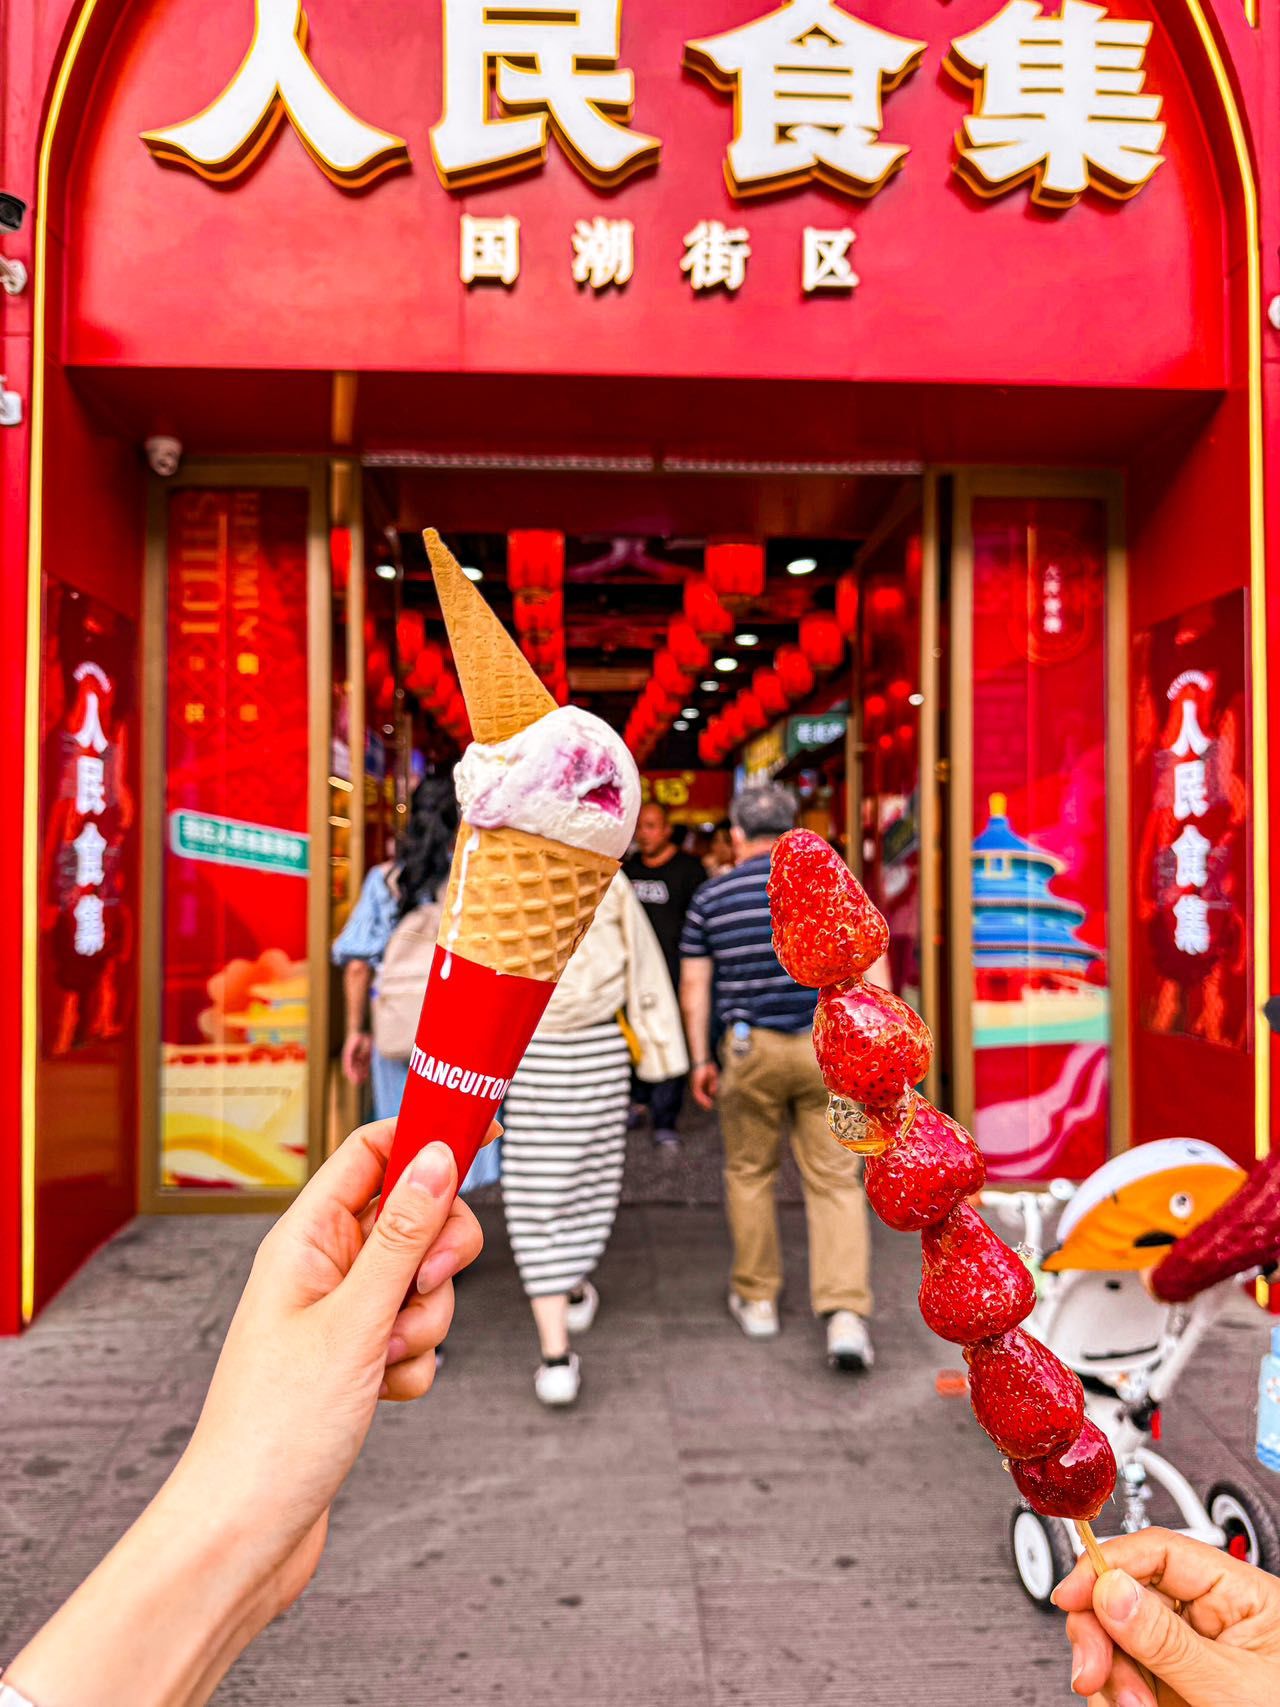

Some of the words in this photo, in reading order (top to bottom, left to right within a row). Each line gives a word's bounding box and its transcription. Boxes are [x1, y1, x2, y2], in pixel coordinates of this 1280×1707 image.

[140, 0, 1167, 207] 人民食集
[459, 214, 860, 291] 国潮街区
